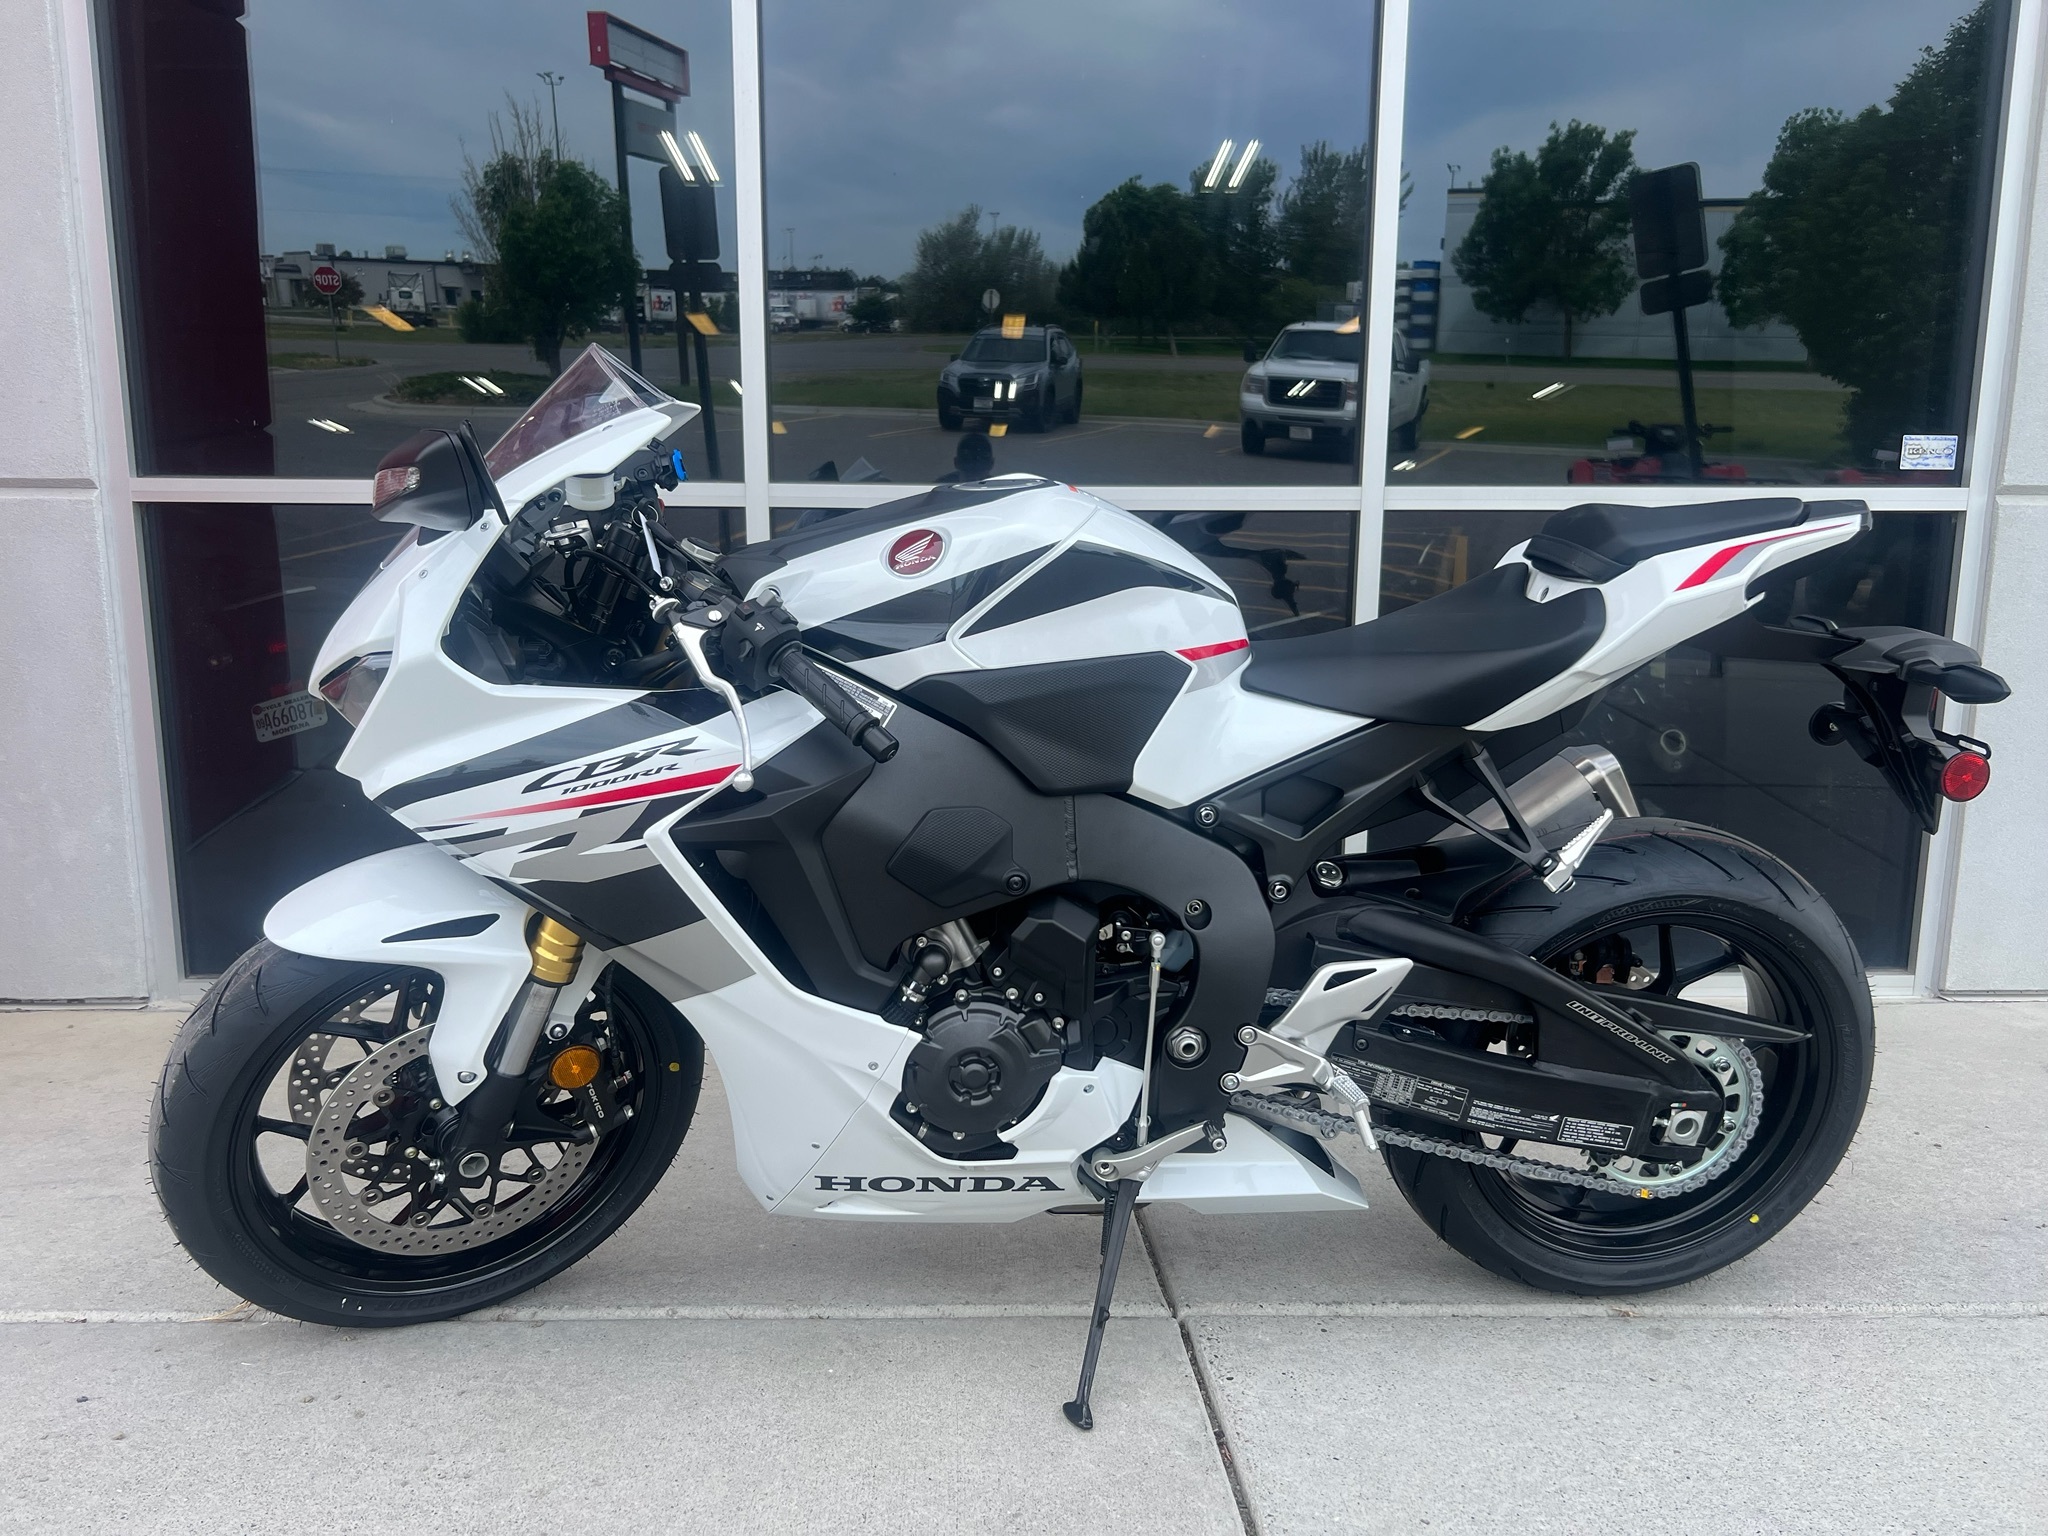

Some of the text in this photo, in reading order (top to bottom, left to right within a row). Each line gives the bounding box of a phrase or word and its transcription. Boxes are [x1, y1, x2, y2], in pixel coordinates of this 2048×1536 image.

[893, 556, 937, 570] HONDA
[264, 700, 314, 731] A66087
[271, 720, 310, 737] MONTANA
[520, 736, 711, 794] CBR
[560, 762, 683, 796] 1000RR
[1566, 1000, 1606, 1024] UNIT
[586, 1082, 605, 1119] TOKICO
[814, 1175, 1065, 1193] HONDA
